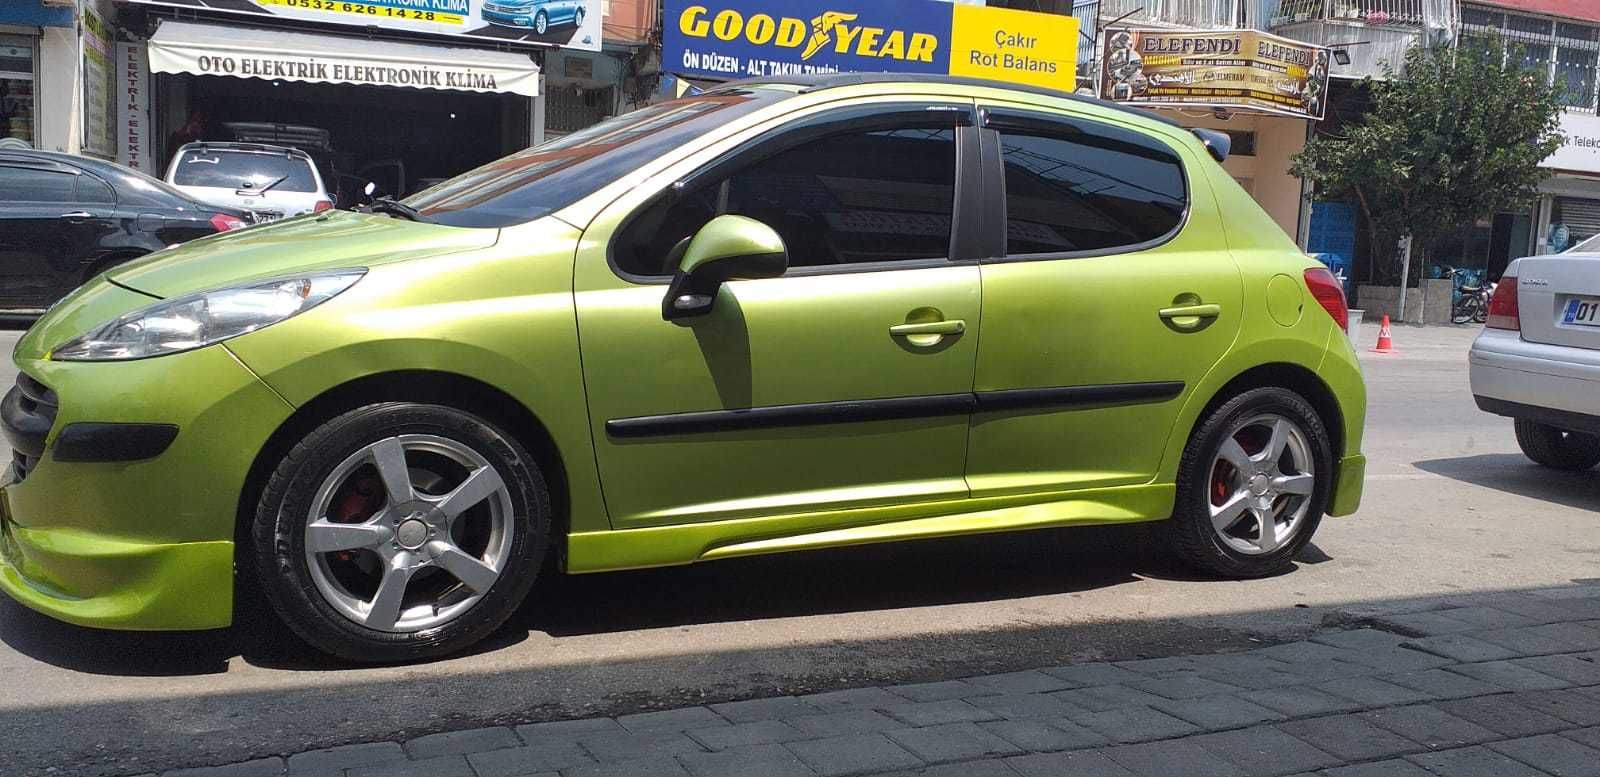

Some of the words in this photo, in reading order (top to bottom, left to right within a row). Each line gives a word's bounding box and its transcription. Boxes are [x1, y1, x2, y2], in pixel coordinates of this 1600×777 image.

[287, 0, 334, 11] 0532
[343, 3, 377, 15] 626
[385, 7, 406, 18] 14
[414, 10, 434, 20] 28
[995, 30, 1037, 48] Çakır
[198, 55, 236, 73] OTO
[241, 58, 329, 79] ELEKTRİK
[333, 64, 441, 86] ELEKTRONİK
[445, 68, 498, 89] KLİMA
[683, 50, 699, 68] ÖN
[702, 52, 739, 73] DÜZEN
[747, 59, 768, 76] ALT
[970, 50, 997, 67] Rot
[1003, 53, 1057, 73] Balans
[1576, 303, 1598, 321] 01
